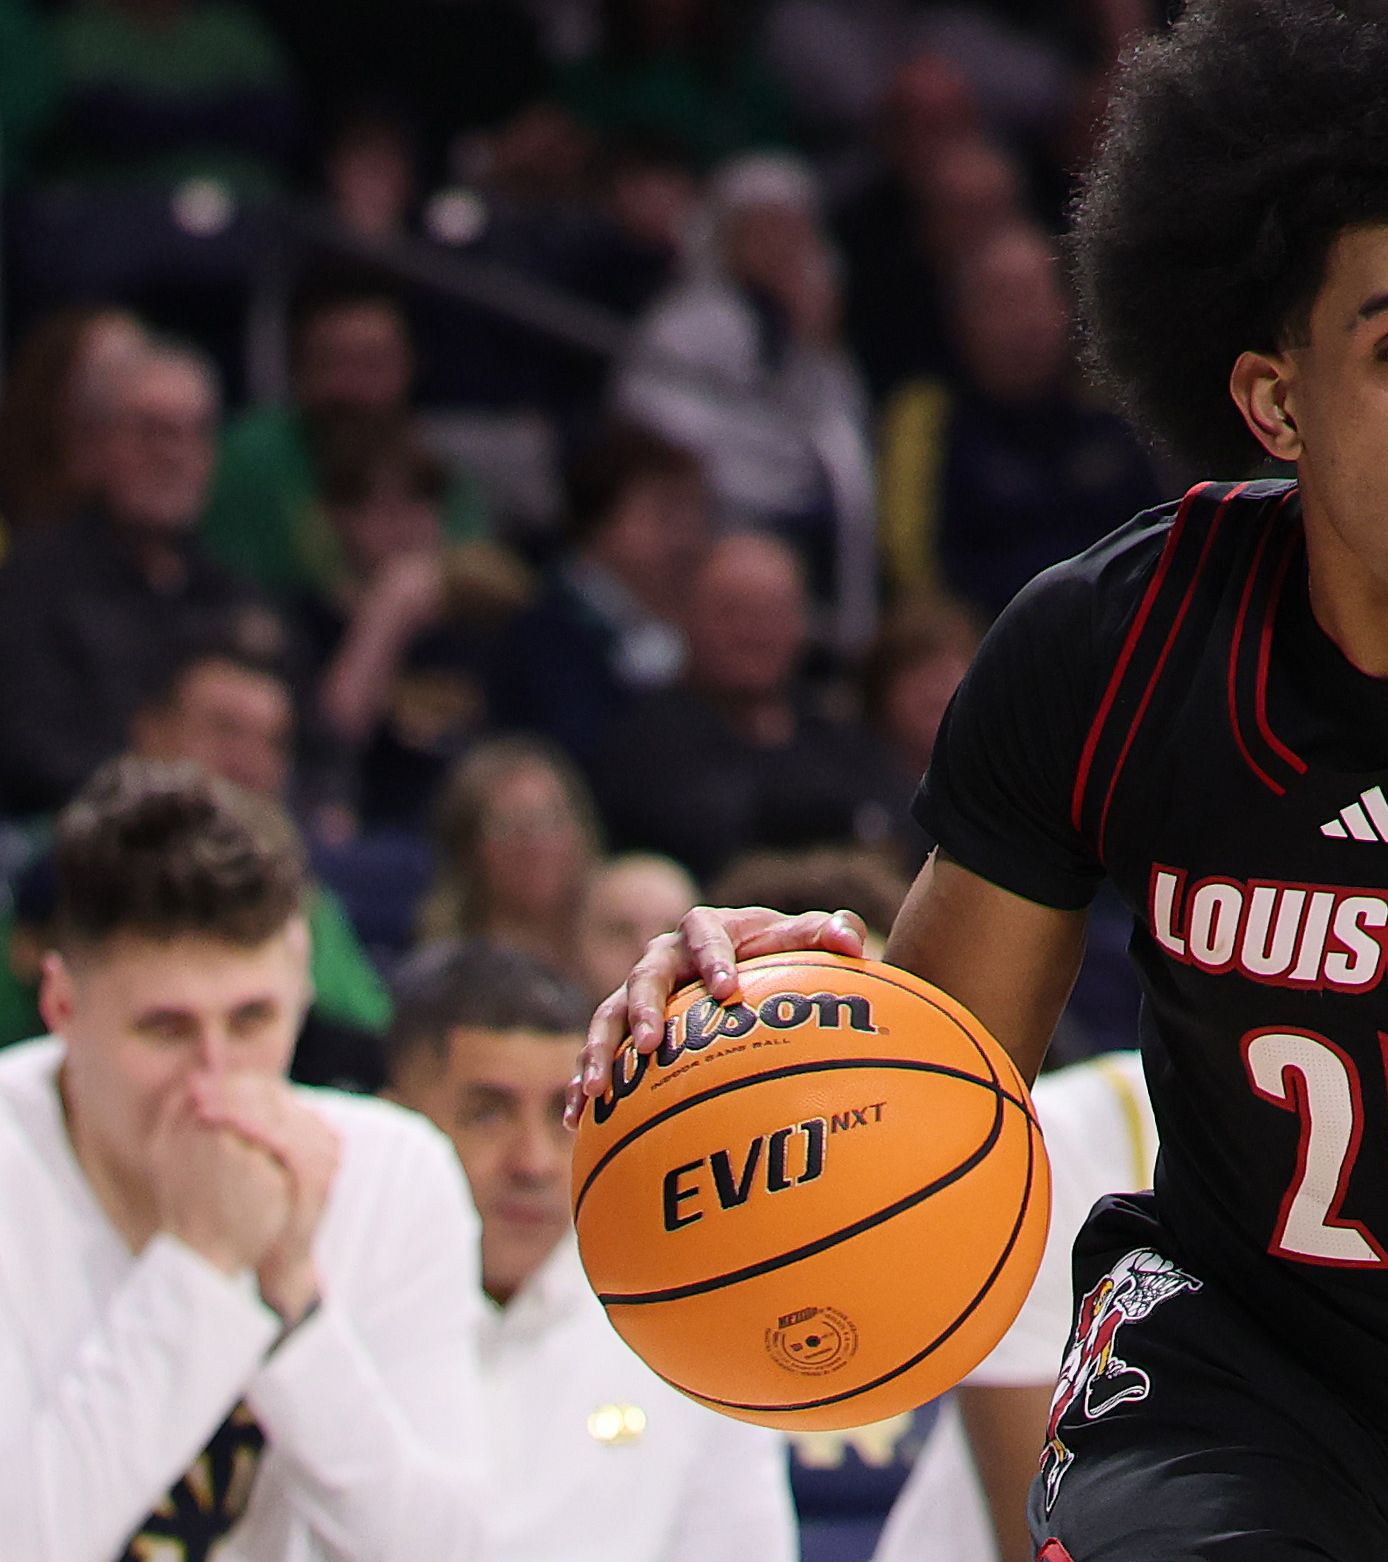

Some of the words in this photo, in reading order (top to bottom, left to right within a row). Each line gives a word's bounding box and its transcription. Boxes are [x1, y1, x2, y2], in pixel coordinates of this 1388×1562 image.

[651, 1060, 700, 1091] INDOOR
[704, 1045, 747, 1062] GAME
[752, 1038, 790, 1049] BALL
[662, 1117, 828, 1232] EVO
[830, 1102, 887, 1134] NXT
